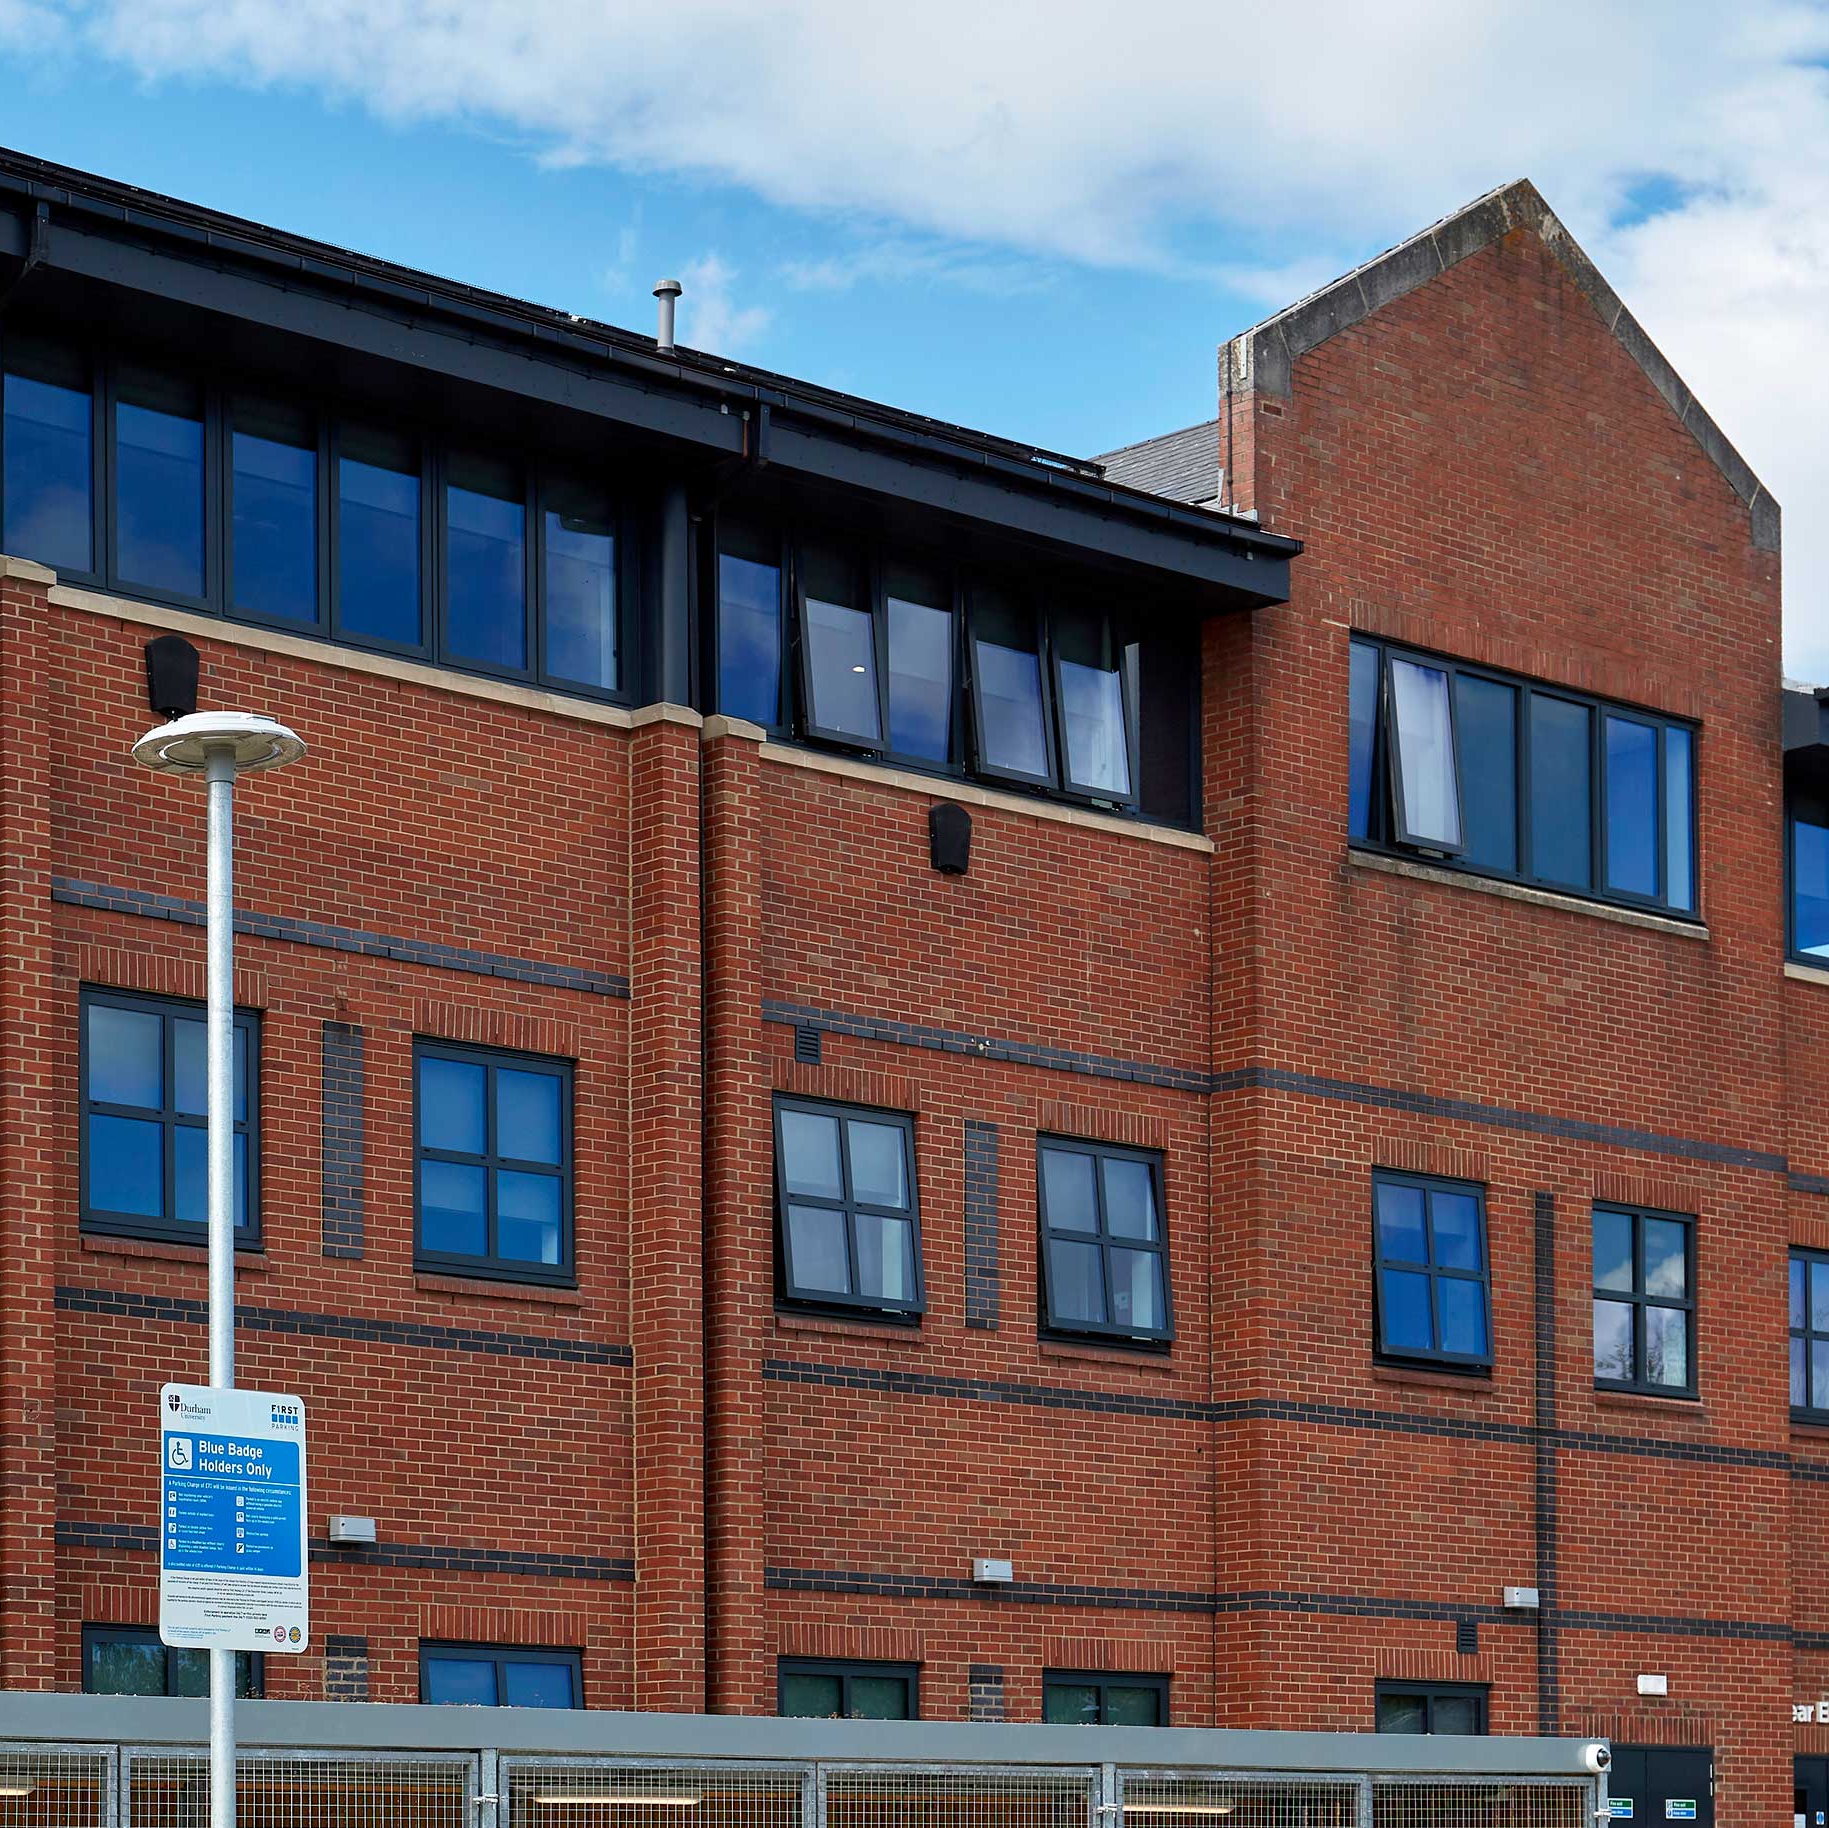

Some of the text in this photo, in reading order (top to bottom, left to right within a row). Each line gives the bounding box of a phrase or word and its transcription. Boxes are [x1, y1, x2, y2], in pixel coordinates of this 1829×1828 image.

[180, 1403, 211, 1414] Durham
[271, 1423, 299, 1431] PARKING
[199, 1440, 263, 1460] Blue Badge
[199, 1458, 272, 1479] Holders Only
